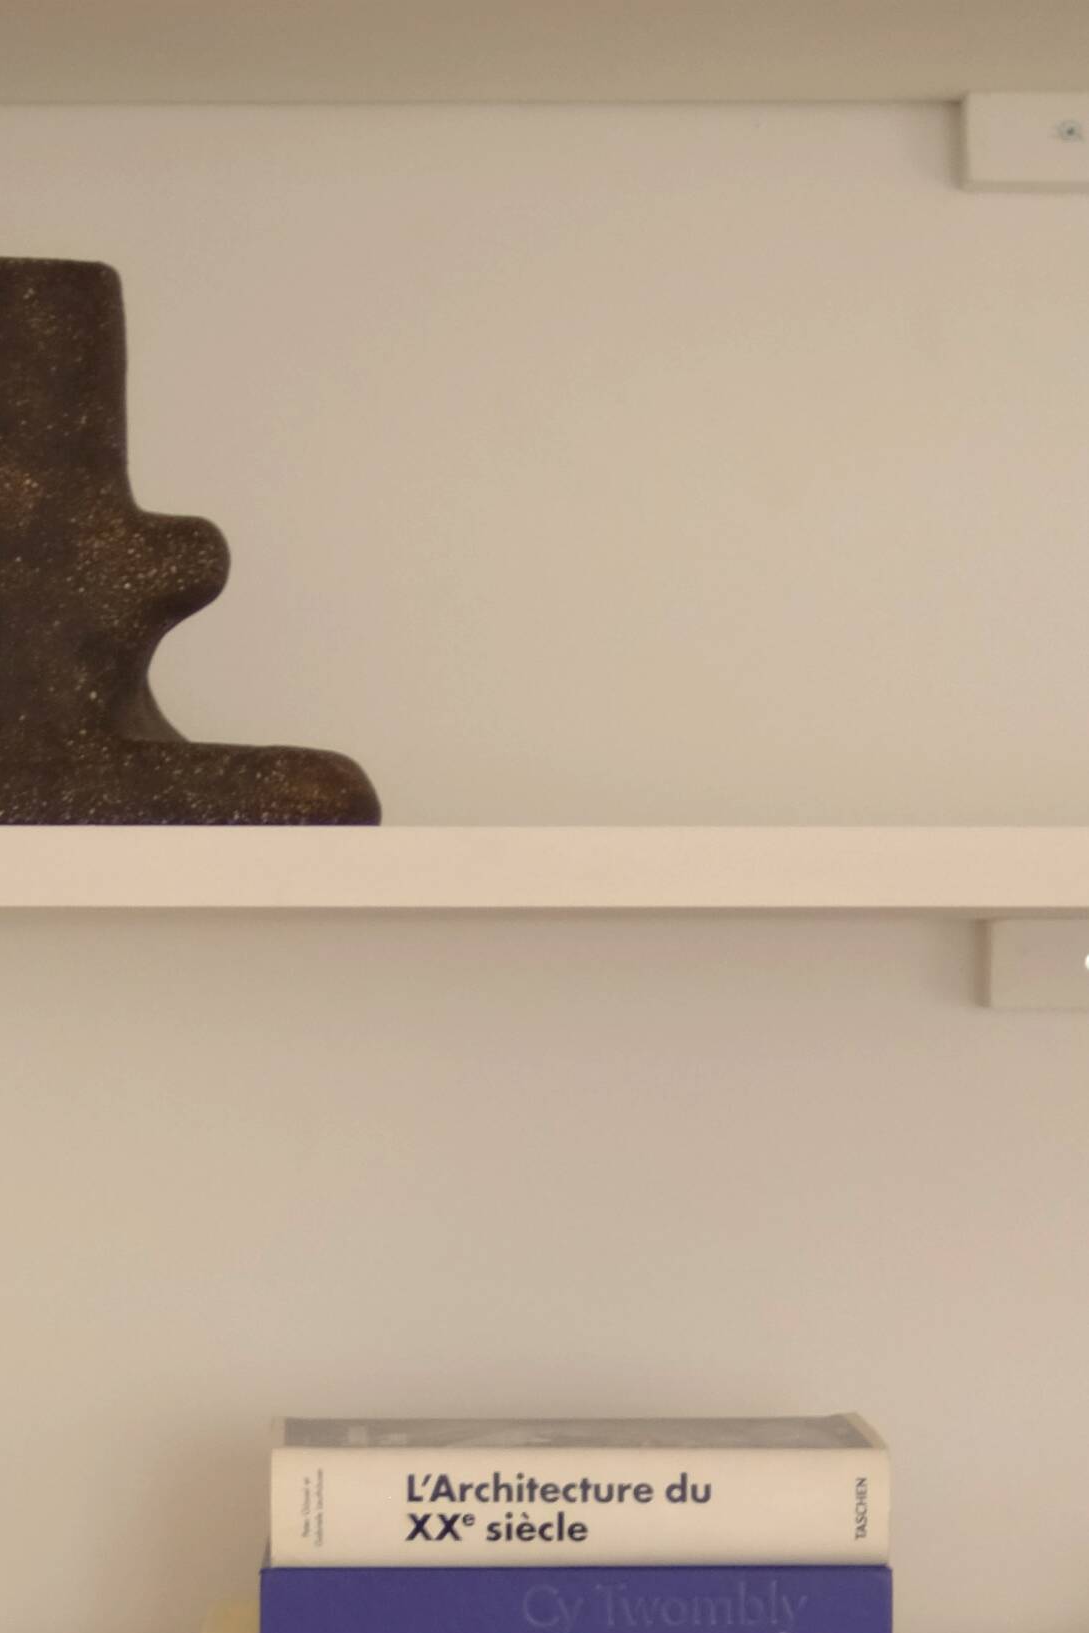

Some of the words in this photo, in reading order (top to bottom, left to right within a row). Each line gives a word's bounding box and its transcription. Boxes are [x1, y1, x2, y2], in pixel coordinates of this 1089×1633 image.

[406, 1472, 654, 1504] L'Architecture
[664, 1470, 711, 1504] du
[484, 1509, 588, 1543] siècle
[854, 1477, 868, 1541] TASCHEN
